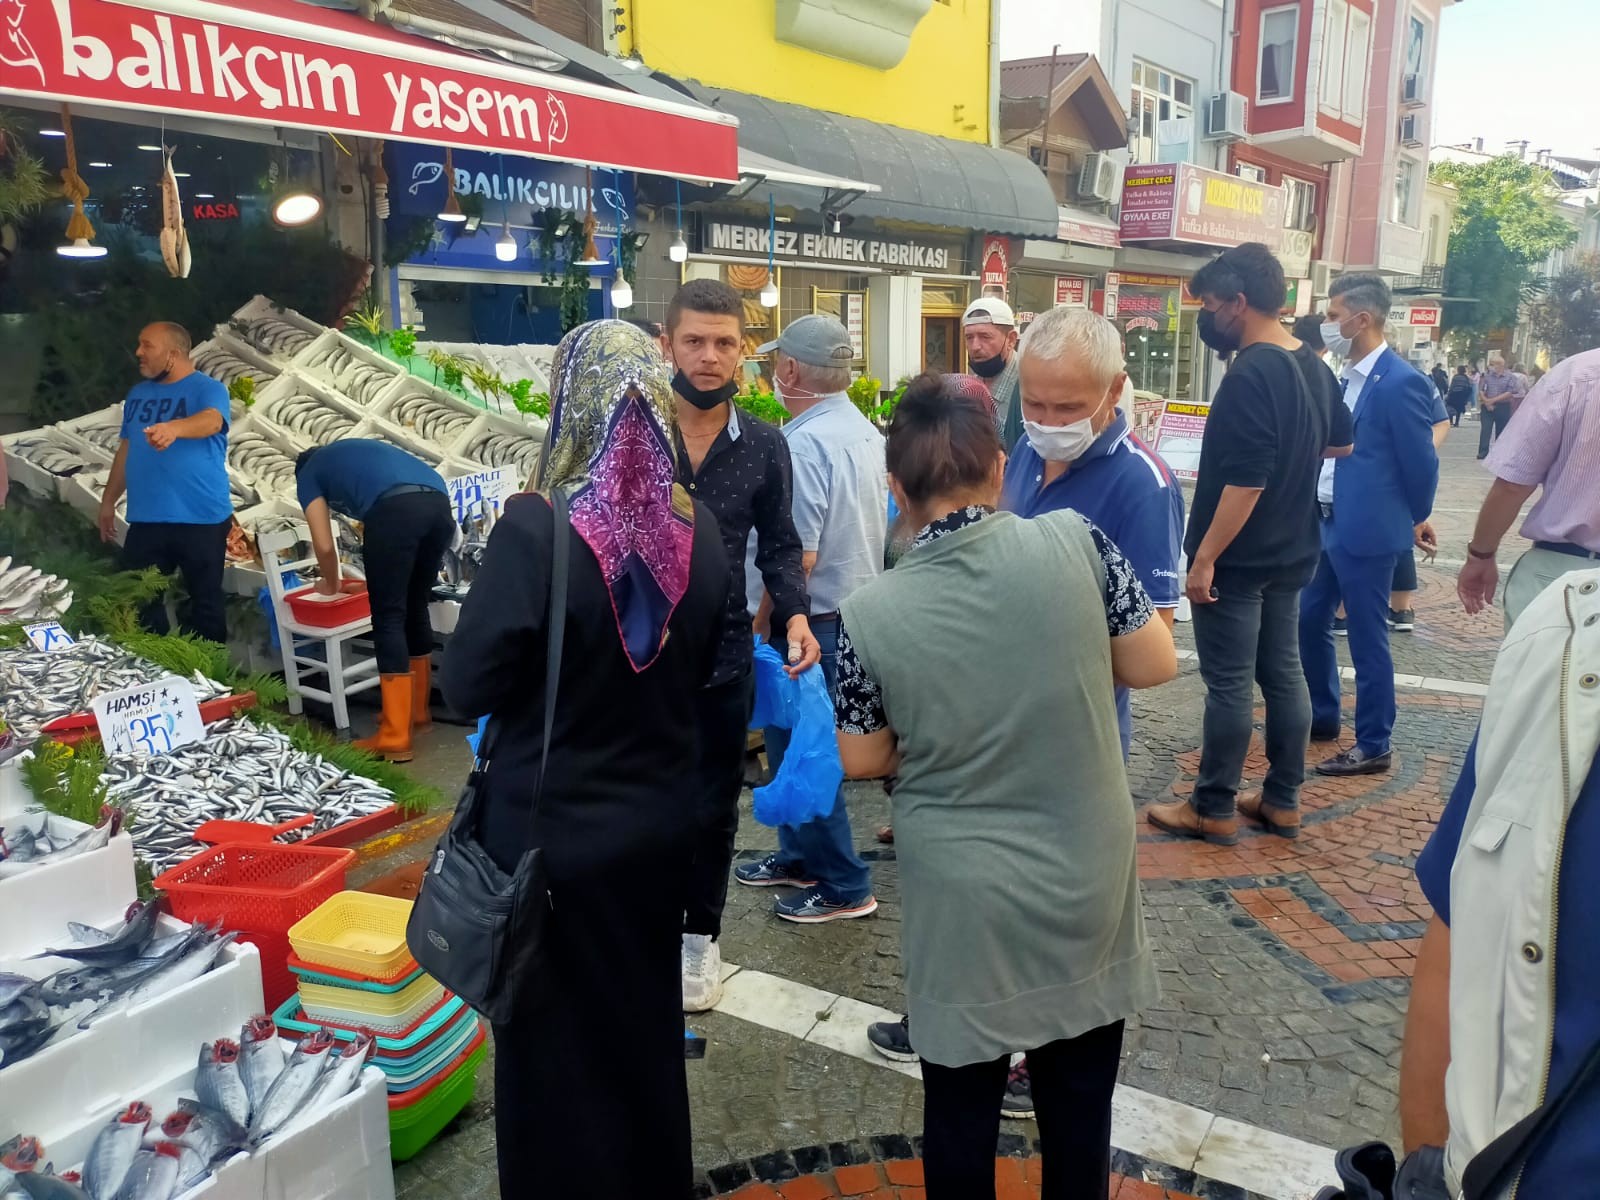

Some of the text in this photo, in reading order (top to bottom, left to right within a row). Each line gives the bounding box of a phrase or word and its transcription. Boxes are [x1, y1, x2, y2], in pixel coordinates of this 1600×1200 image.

[53, 0, 542, 142] balıkçım yasem
[1126, 177, 1154, 187] MEHMET
[193, 203, 239, 219] KASA
[712, 222, 948, 269] MERKEZ EKMEK FABRİKASI
[124, 397, 188, 424] USPA
